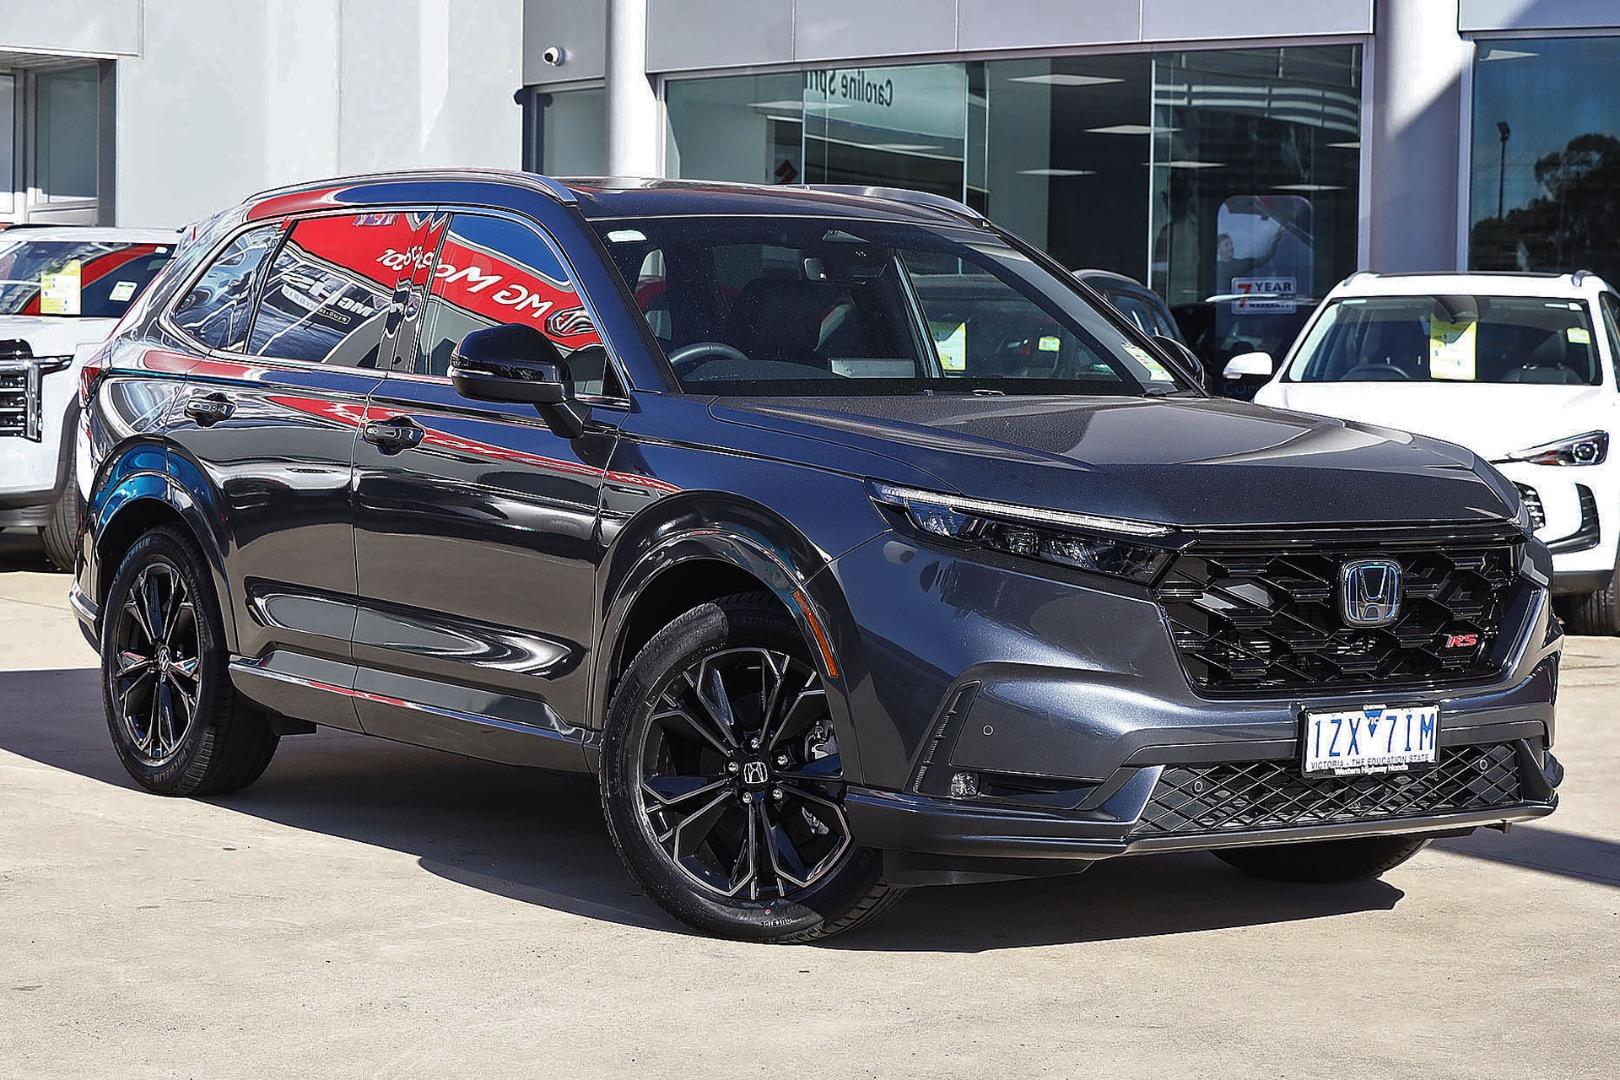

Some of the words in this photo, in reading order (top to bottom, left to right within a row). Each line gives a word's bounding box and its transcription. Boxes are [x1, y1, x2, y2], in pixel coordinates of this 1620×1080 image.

[1237, 283, 1253, 308] 7
[1255, 282, 1291, 292] YEAR
[1446, 634, 1478, 648] RS
[1315, 717, 1361, 758] 1ZX
[1386, 713, 1435, 754] 7IM
[1311, 759, 1344, 770] VICTORIA
[1351, 759, 1365, 767] THE
[1367, 756, 1407, 765] EDUCATION
[1408, 753, 1430, 761] STATE
[1334, 767, 1361, 776] Western
[1361, 765, 1388, 775] Highway
[1388, 763, 1409, 772] Honda
